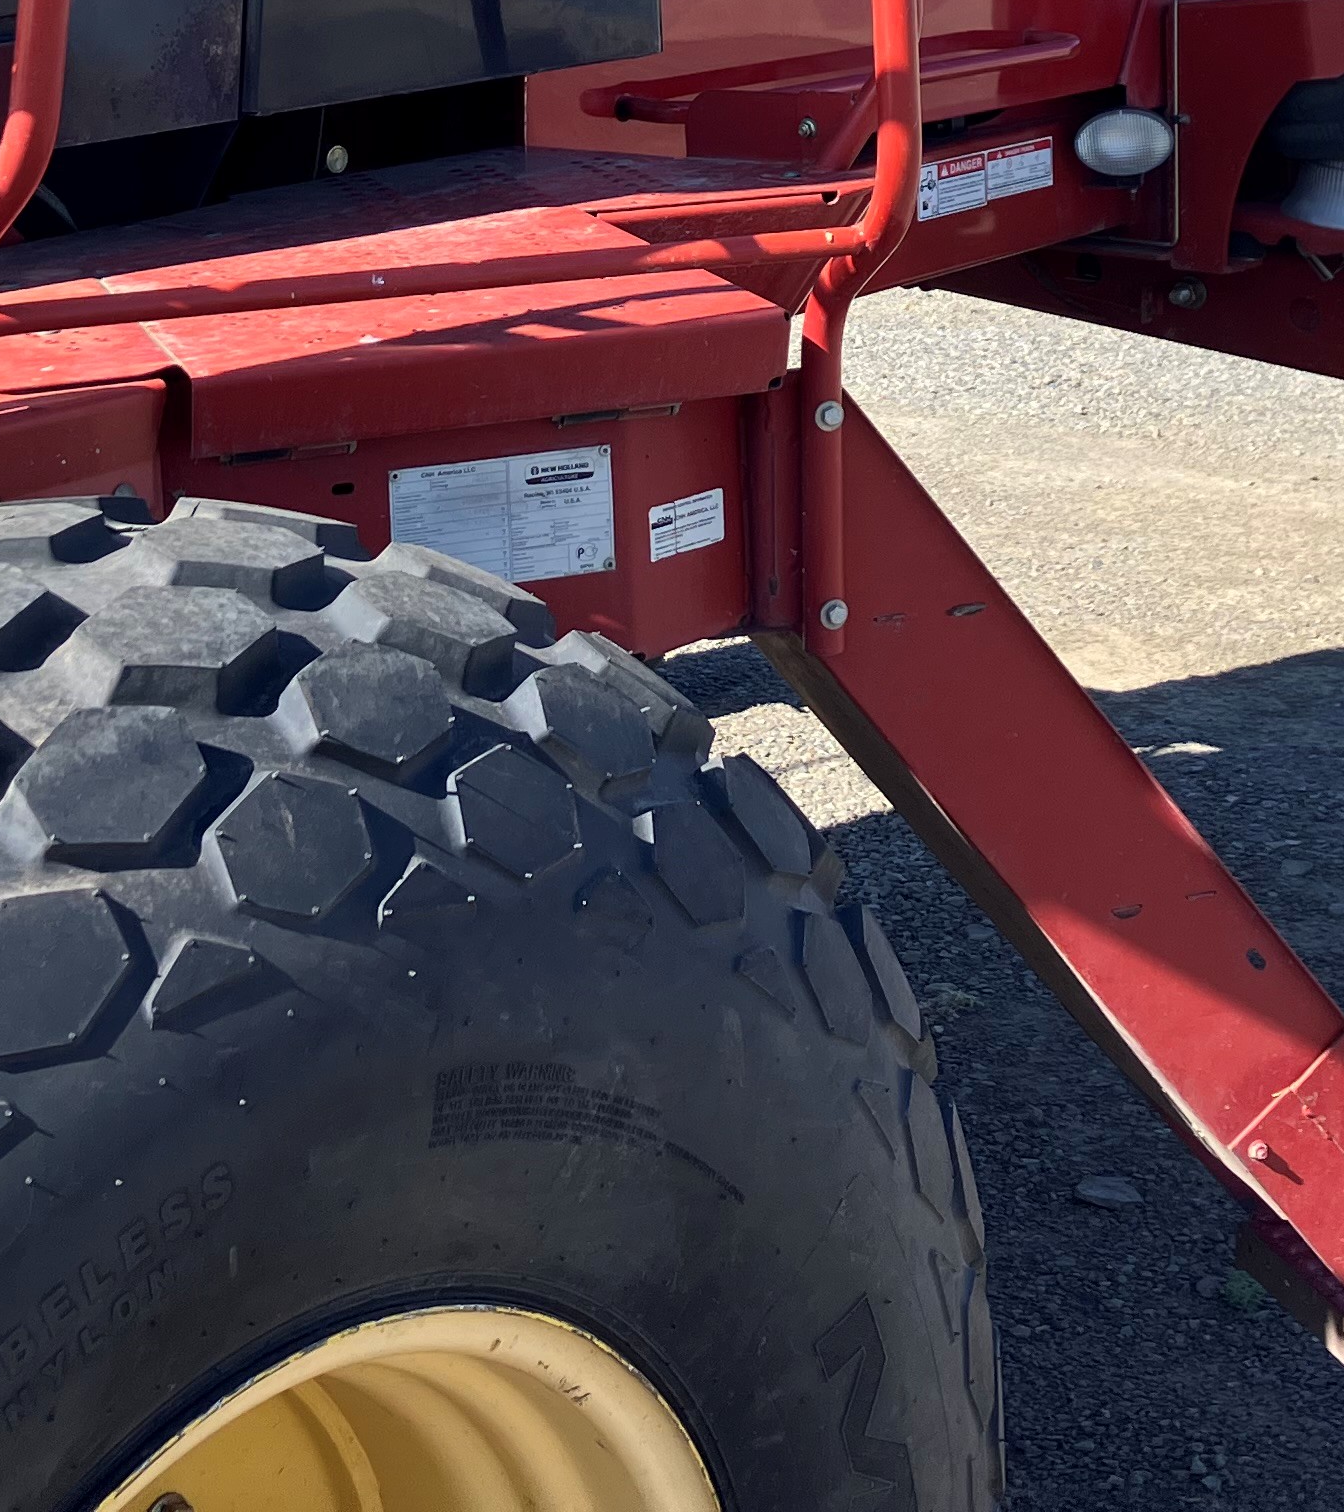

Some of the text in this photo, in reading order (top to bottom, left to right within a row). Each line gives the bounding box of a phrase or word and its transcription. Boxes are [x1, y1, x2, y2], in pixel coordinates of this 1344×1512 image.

[949, 157, 983, 174] DANGER
[437, 469, 462, 477] America
[463, 466, 476, 474] LLC
[540, 462, 590, 474] NEW HOLLAND
